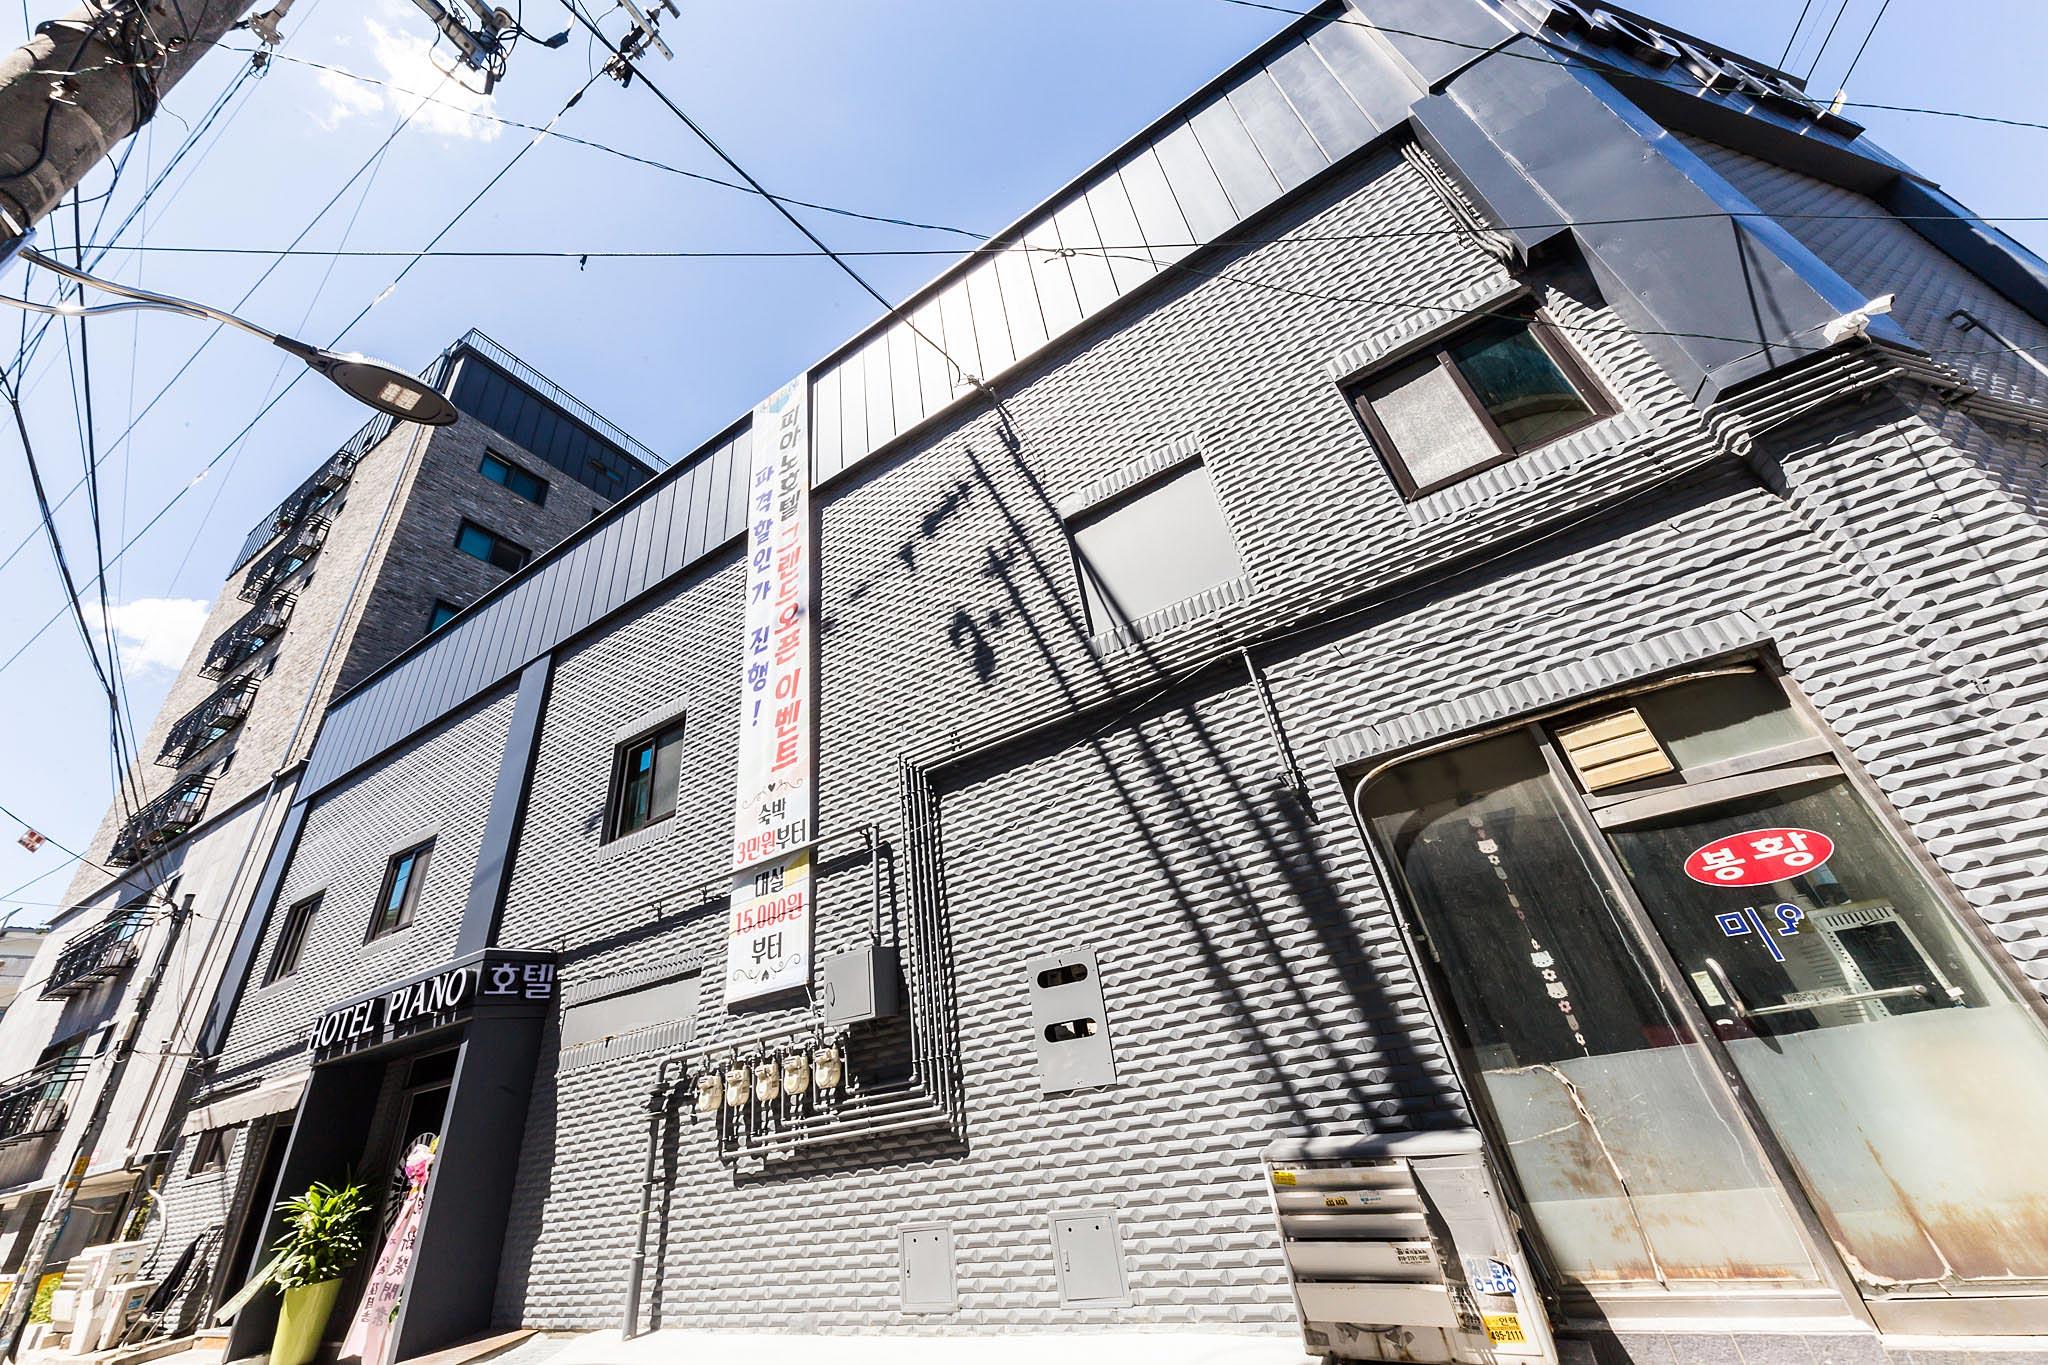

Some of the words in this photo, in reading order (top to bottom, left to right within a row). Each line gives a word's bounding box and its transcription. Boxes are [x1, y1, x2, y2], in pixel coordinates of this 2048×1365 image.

[771, 668, 801, 772] 이벤트
[758, 797, 787, 825] 숙박
[1701, 832, 1815, 881] 봉황
[755, 866, 785, 897] 대실
[751, 933, 784, 966] 부터
[484, 962, 555, 999] 호텔
[307, 998, 376, 1051] HOTEL
[384, 967, 467, 1026] PIANO
